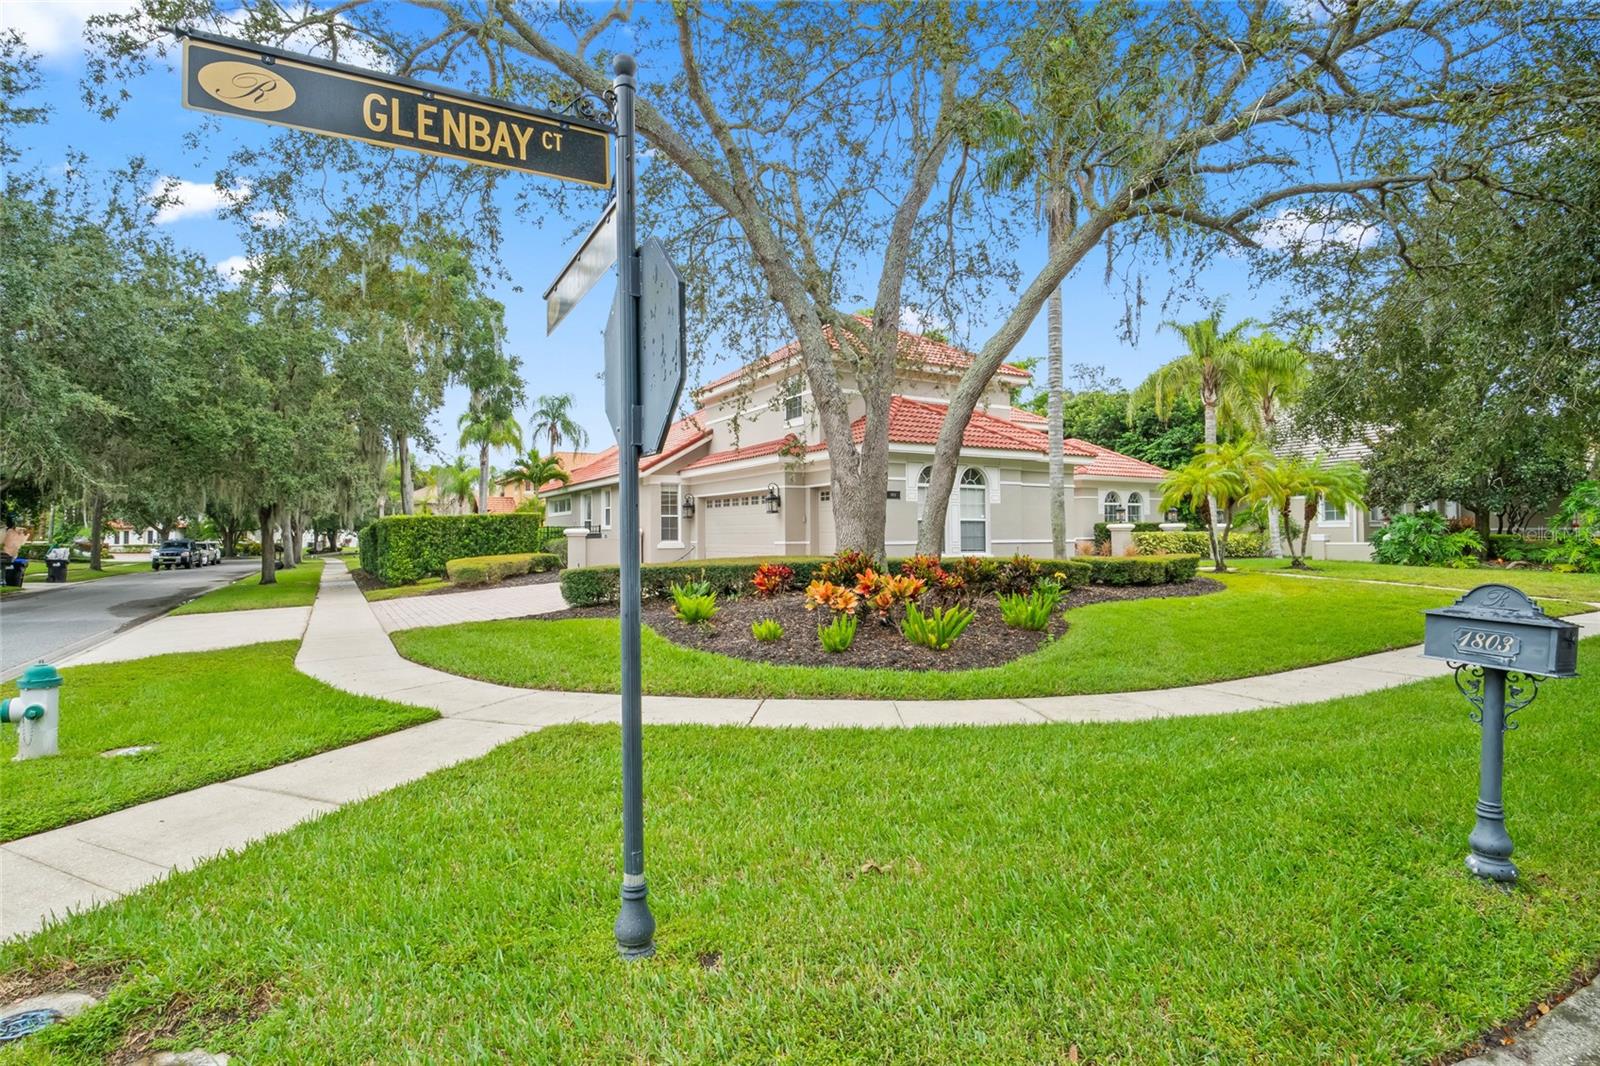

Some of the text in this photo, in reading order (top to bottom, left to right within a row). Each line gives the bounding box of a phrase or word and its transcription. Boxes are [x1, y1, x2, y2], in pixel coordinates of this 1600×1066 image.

[362, 92, 534, 161] GLENBAY
[541, 130, 563, 152] CT
[1457, 631, 1515, 653] 1803
